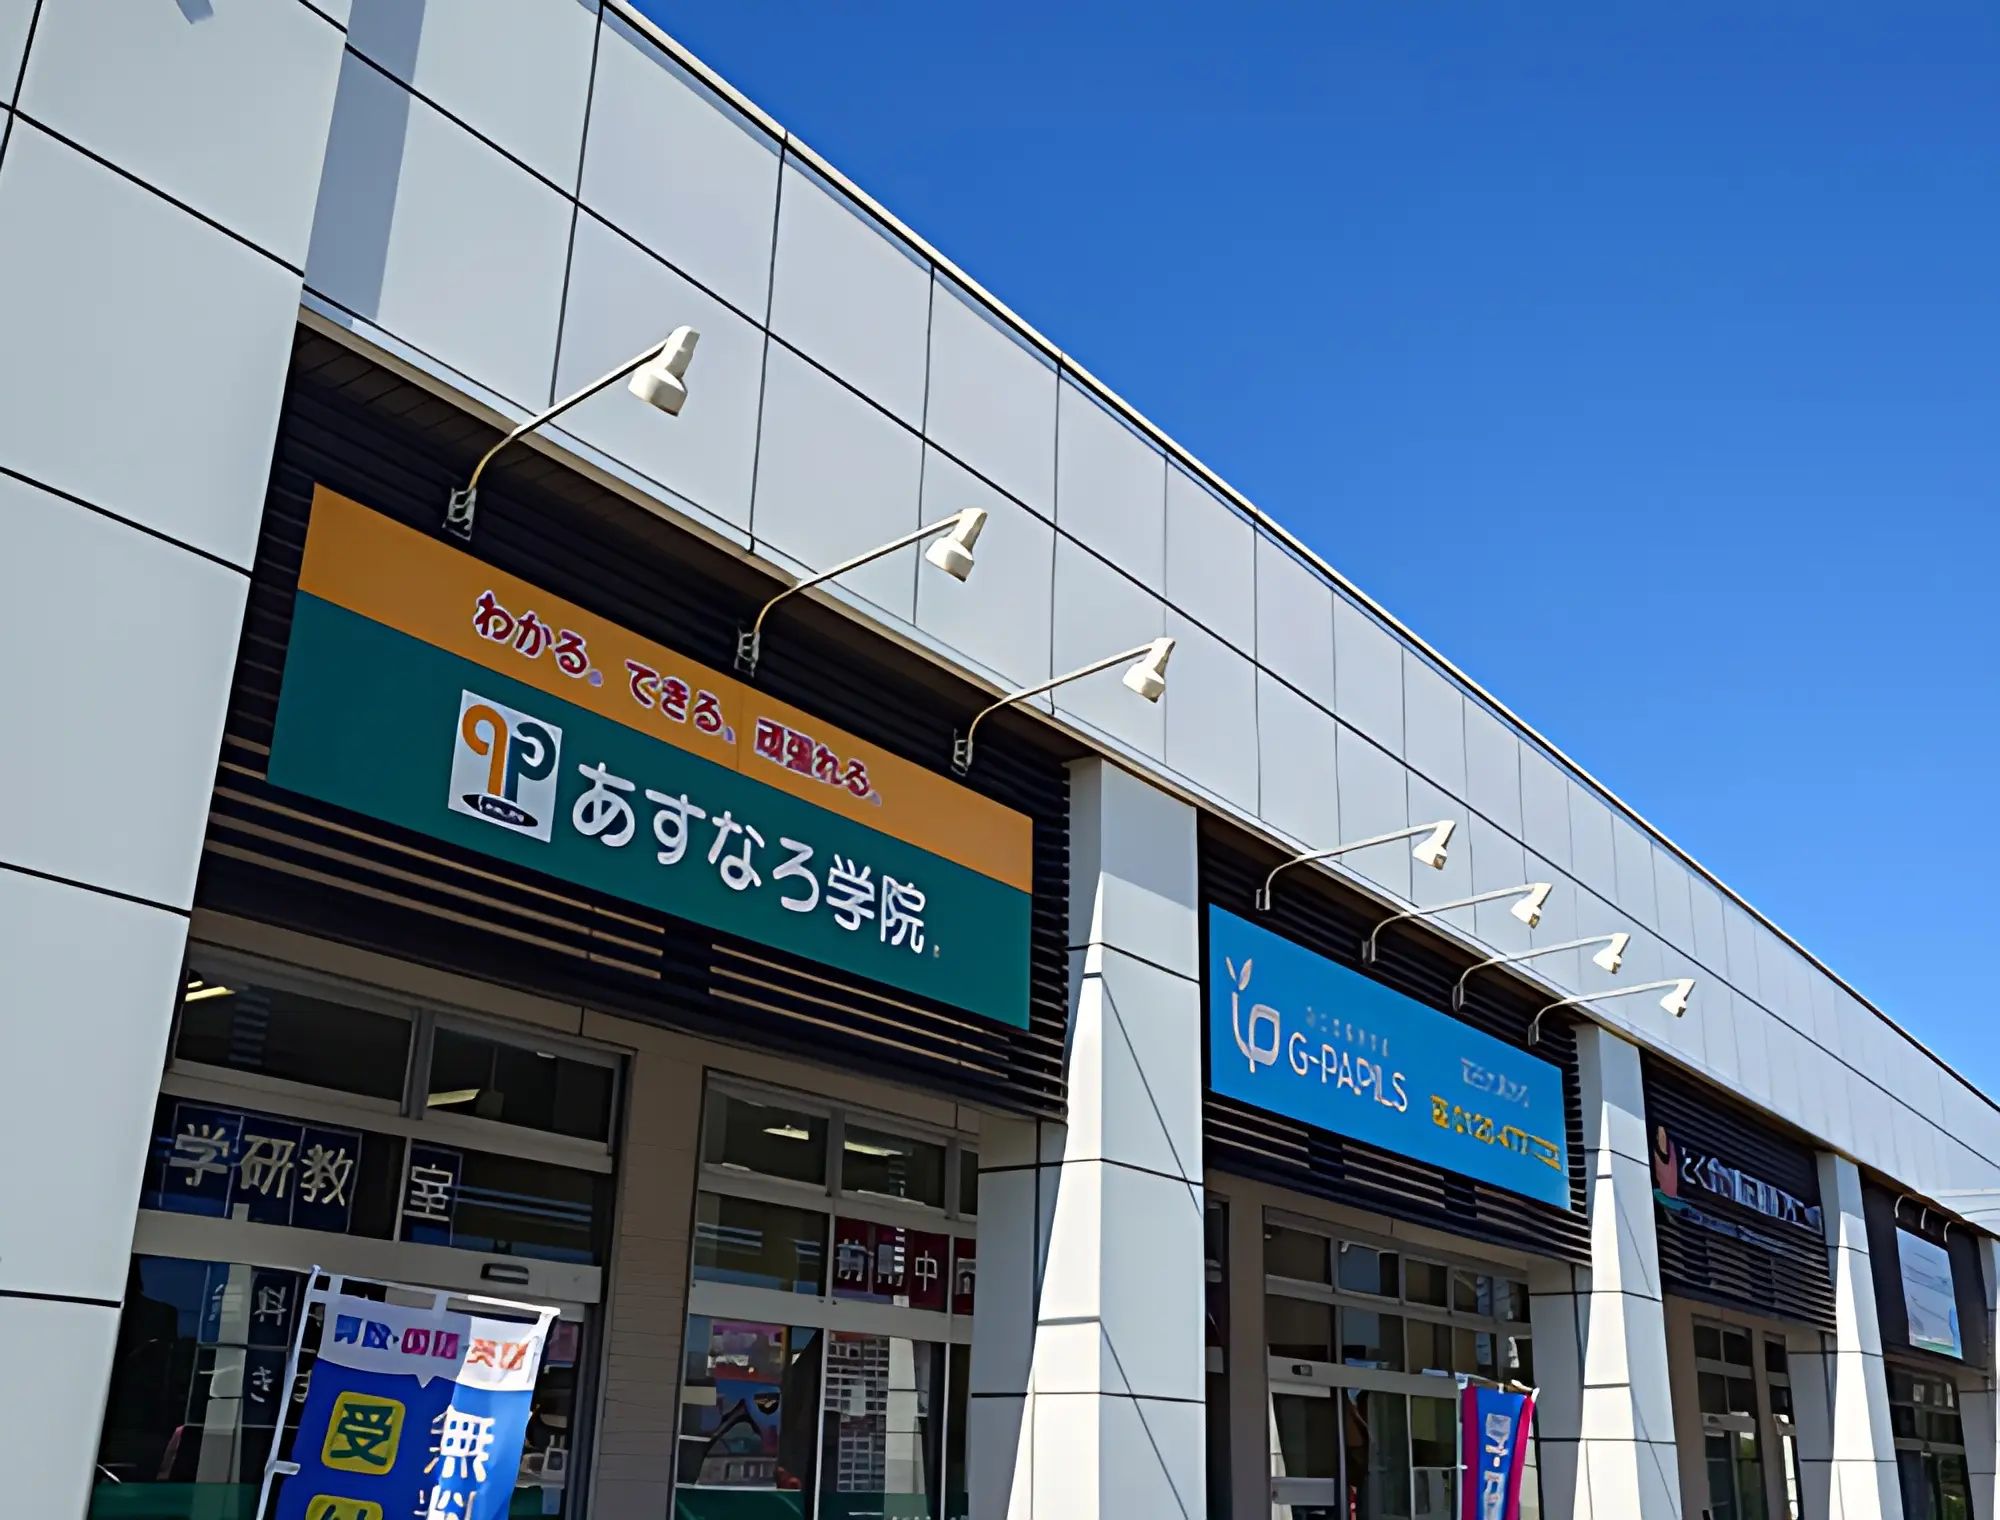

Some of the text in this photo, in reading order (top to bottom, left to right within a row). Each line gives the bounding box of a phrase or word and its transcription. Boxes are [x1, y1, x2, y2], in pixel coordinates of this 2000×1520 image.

[572, 762, 927, 953] あすなろ学院
